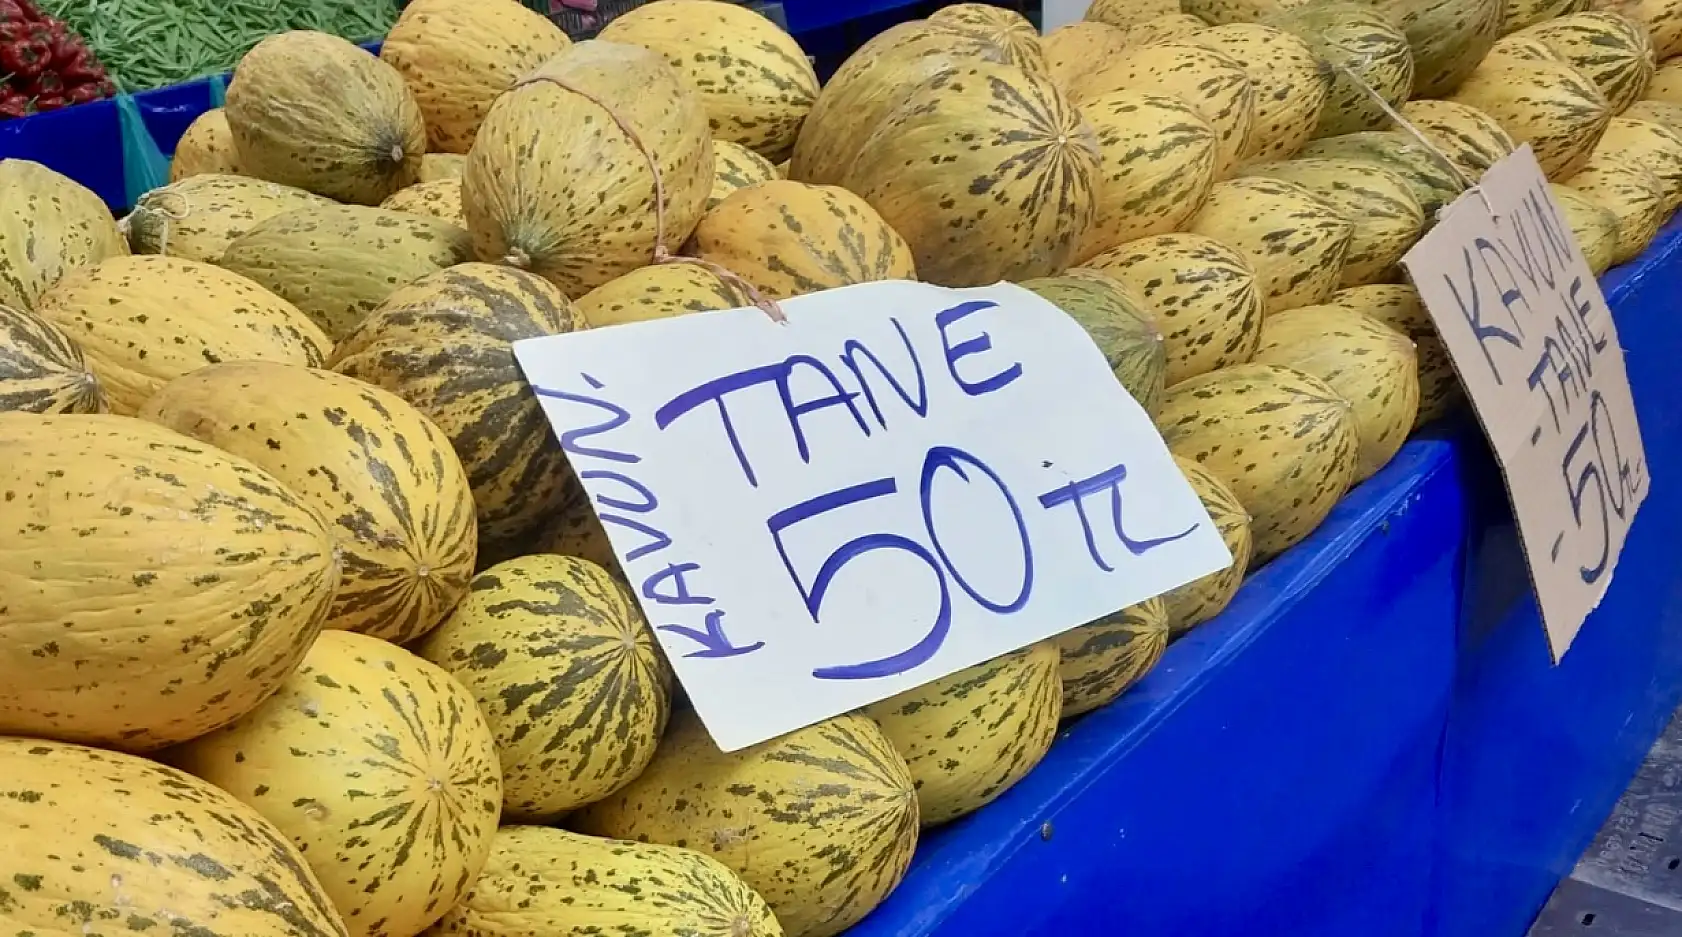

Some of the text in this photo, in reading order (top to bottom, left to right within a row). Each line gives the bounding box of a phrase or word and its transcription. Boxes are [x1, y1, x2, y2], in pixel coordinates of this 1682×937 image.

[1443, 179, 1573, 386] KAVUN
[655, 301, 1022, 487] TANE
[767, 446, 1199, 680] 50 TL
